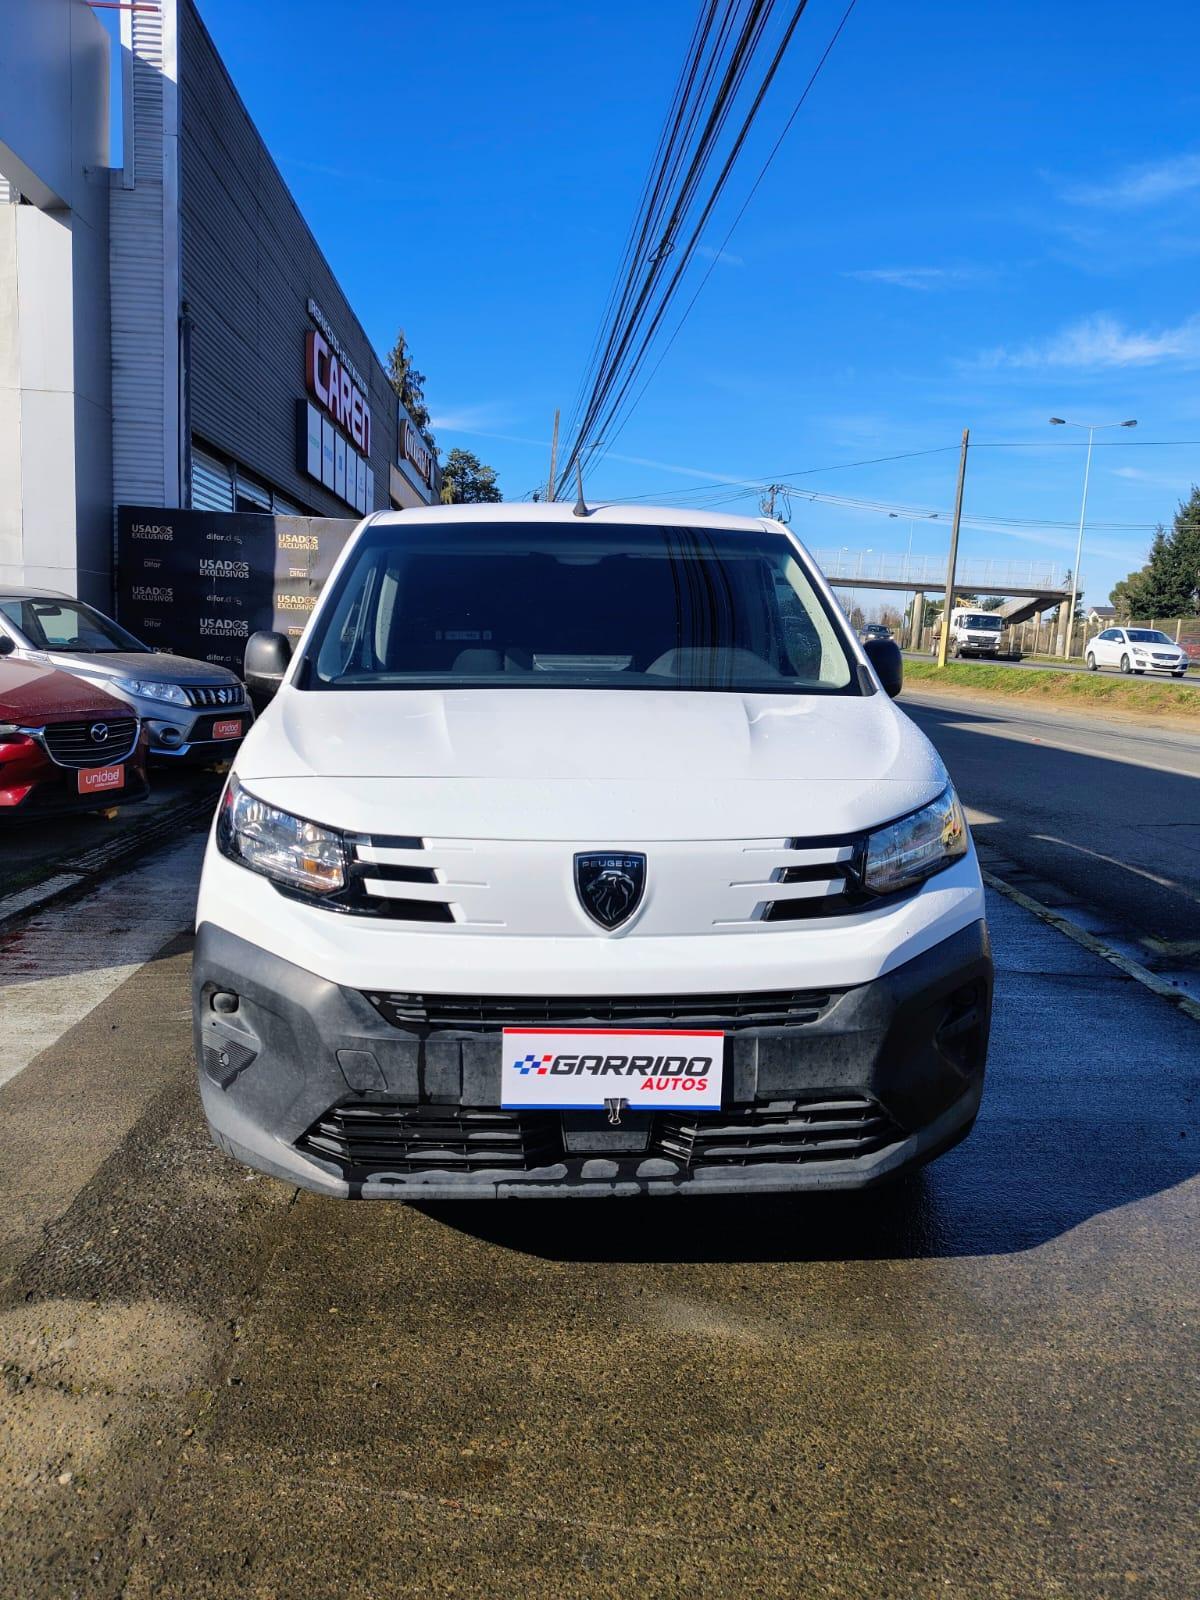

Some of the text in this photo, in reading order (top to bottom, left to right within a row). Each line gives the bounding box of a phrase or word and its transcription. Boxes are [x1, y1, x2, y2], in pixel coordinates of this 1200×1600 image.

[313, 330, 371, 457] CAREN
[131, 524, 173, 535] USADOS
[131, 532, 173, 541] EXCLUSIVOS
[278, 534, 319, 545] USADOS
[278, 542, 319, 551] EXCLUSIVOS
[199, 559, 249, 572] USADOS
[199, 569, 249, 579] EXCLUSIVOS
[132, 586, 174, 596] USADOS
[132, 594, 174, 602] EXCLUSIVOS
[199, 618, 249, 631] USADOS
[199, 627, 249, 637] EXCLUSIVOS
[85, 768, 120, 785] unidad
[582, 859, 640, 869] PEUGEOT
[549, 1054, 713, 1077] GARRIDO
[640, 1077, 708, 1091] AUTOS
